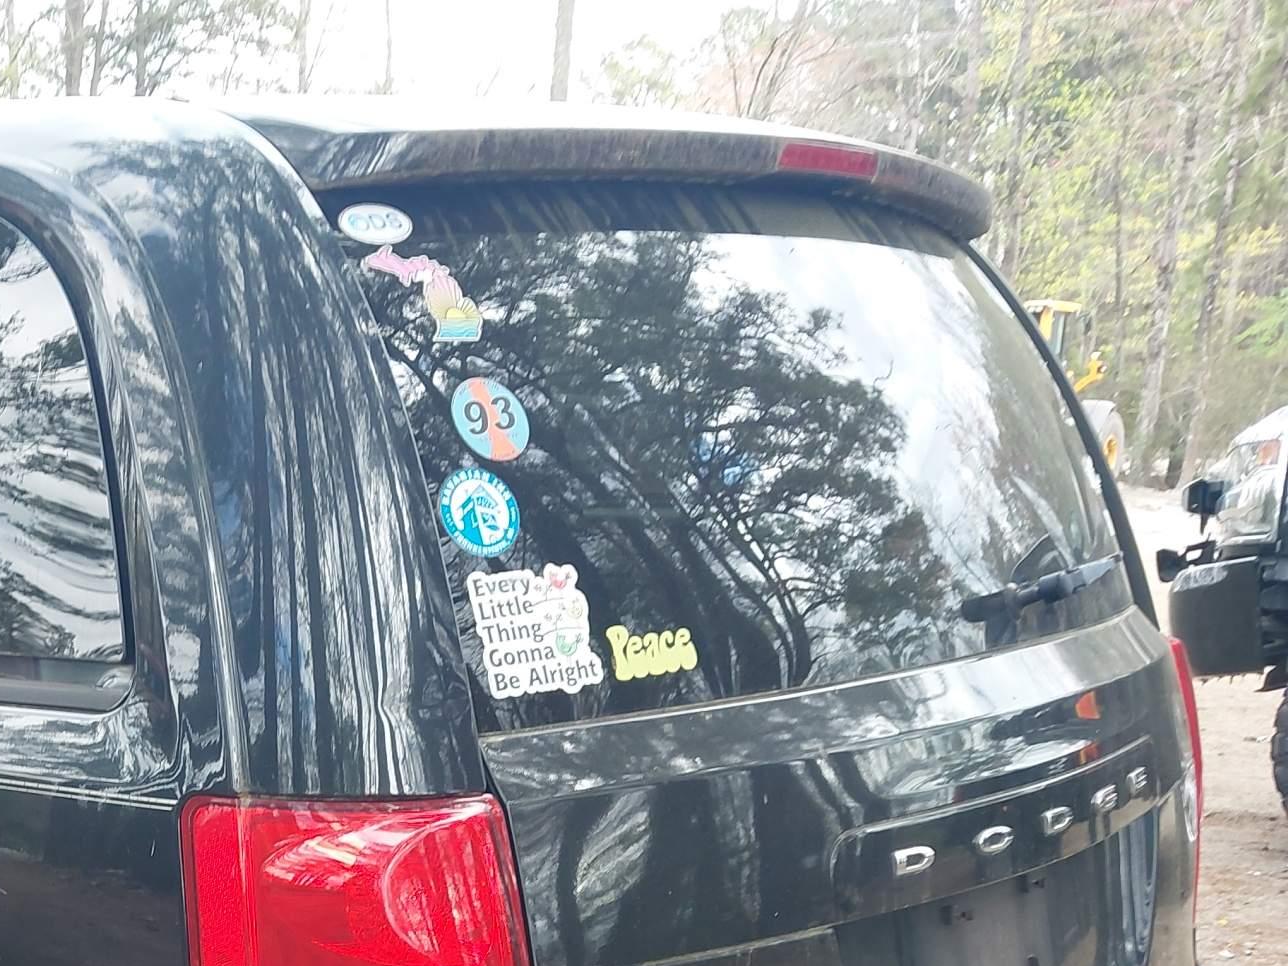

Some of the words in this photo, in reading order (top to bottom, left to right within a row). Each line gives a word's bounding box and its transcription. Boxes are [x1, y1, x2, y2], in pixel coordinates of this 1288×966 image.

[464, 397, 516, 435] 93
[472, 577, 530, 598] Every
[478, 598, 533, 620] Little
[482, 621, 544, 645] Thing
[489, 645, 556, 668] Gonna
[606, 625, 698, 681] Peace
[494, 673, 521, 692] Be
[529, 658, 599, 687] Alright
[893, 767, 1148, 876] DODGE
